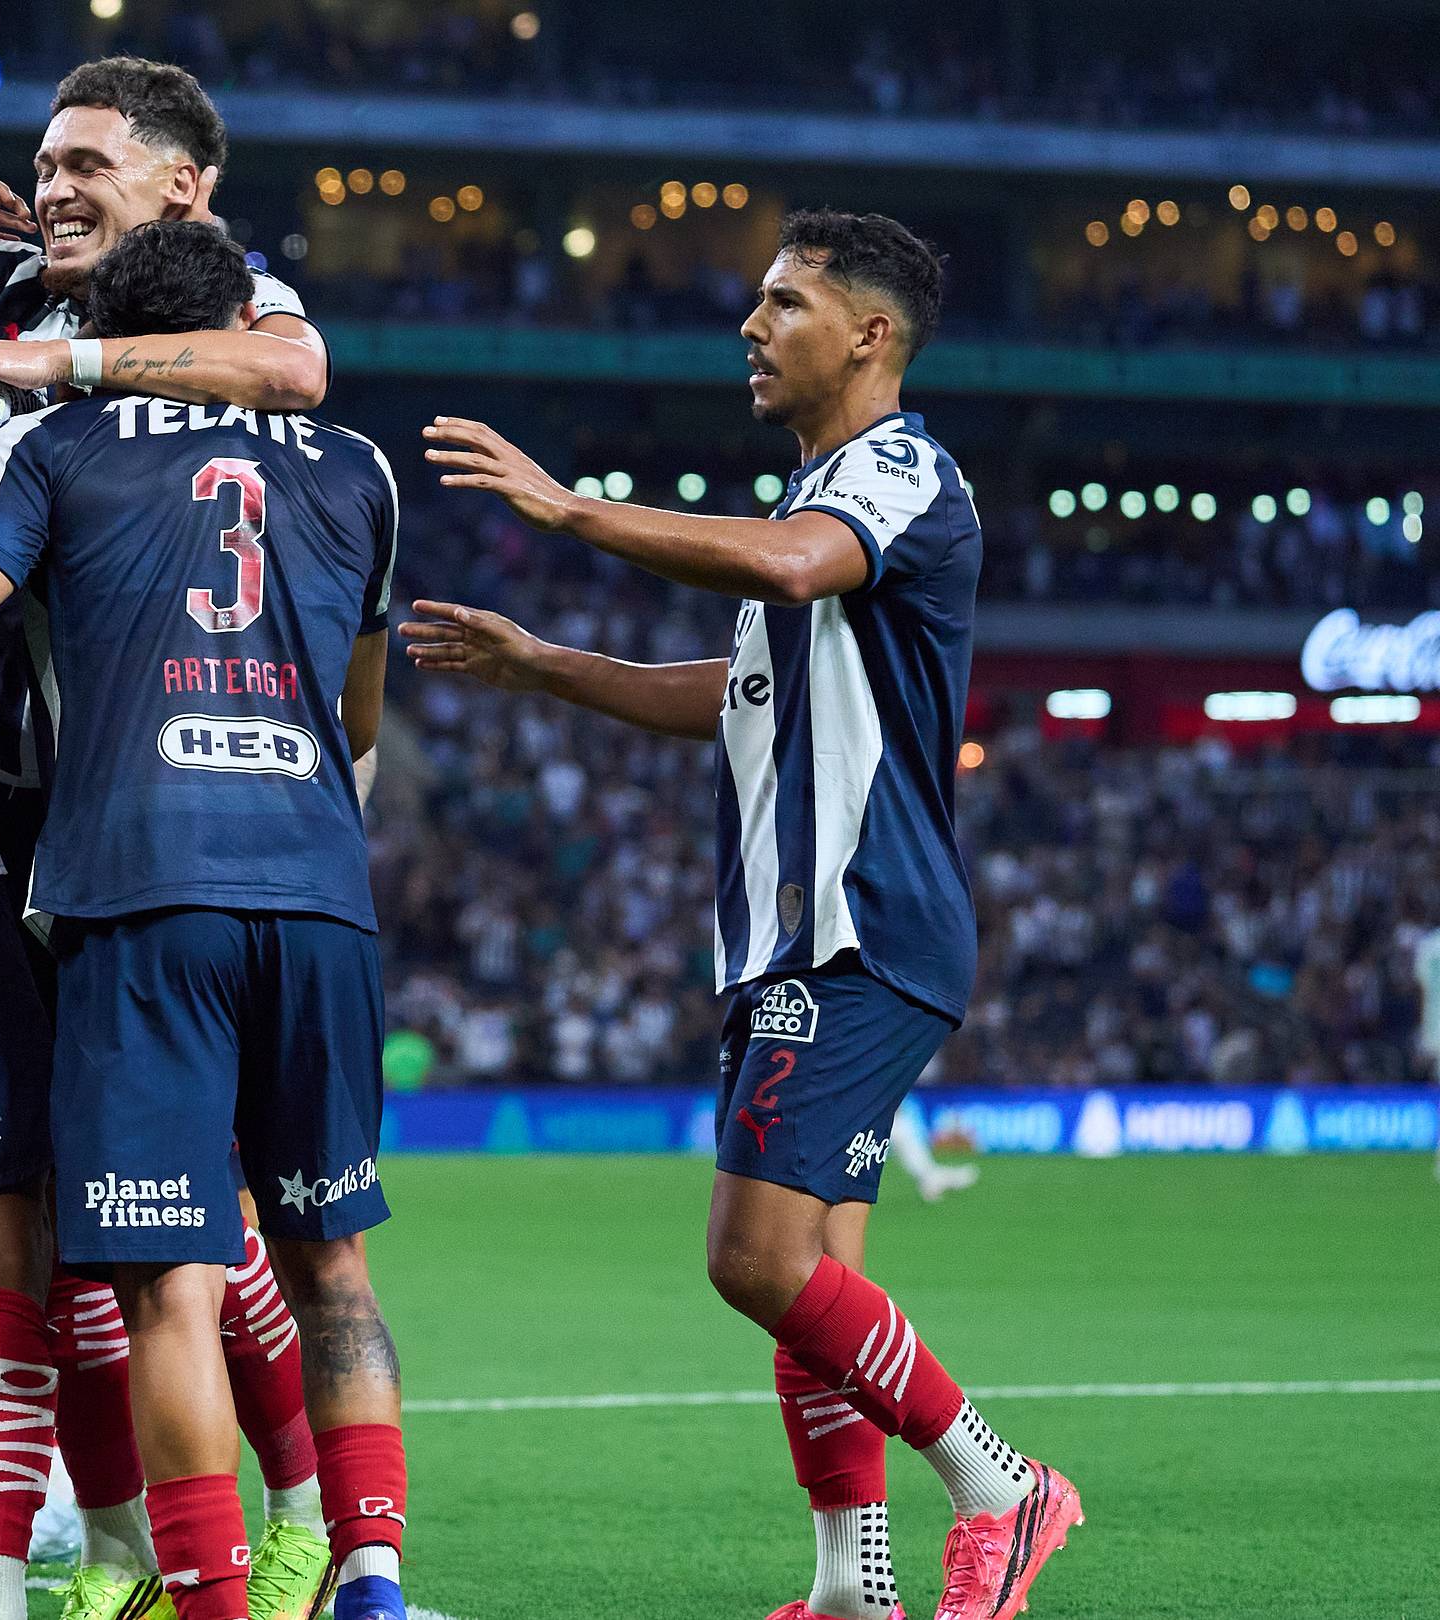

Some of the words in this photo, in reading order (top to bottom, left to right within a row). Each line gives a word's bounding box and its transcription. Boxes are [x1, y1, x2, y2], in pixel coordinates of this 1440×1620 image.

[877, 461, 919, 488] Berel
[186, 457, 266, 633] 3
[163, 658, 297, 700] ARTEAGA
[180, 729, 299, 764] H-E-B
[753, 1013, 802, 1033] LOCO
[762, 995, 806, 1016] OLLO
[752, 1048, 797, 1109] 2
[85, 1172, 191, 1209] planet
[311, 1164, 358, 1207] Carl's
[99, 1199, 206, 1228] fitness
